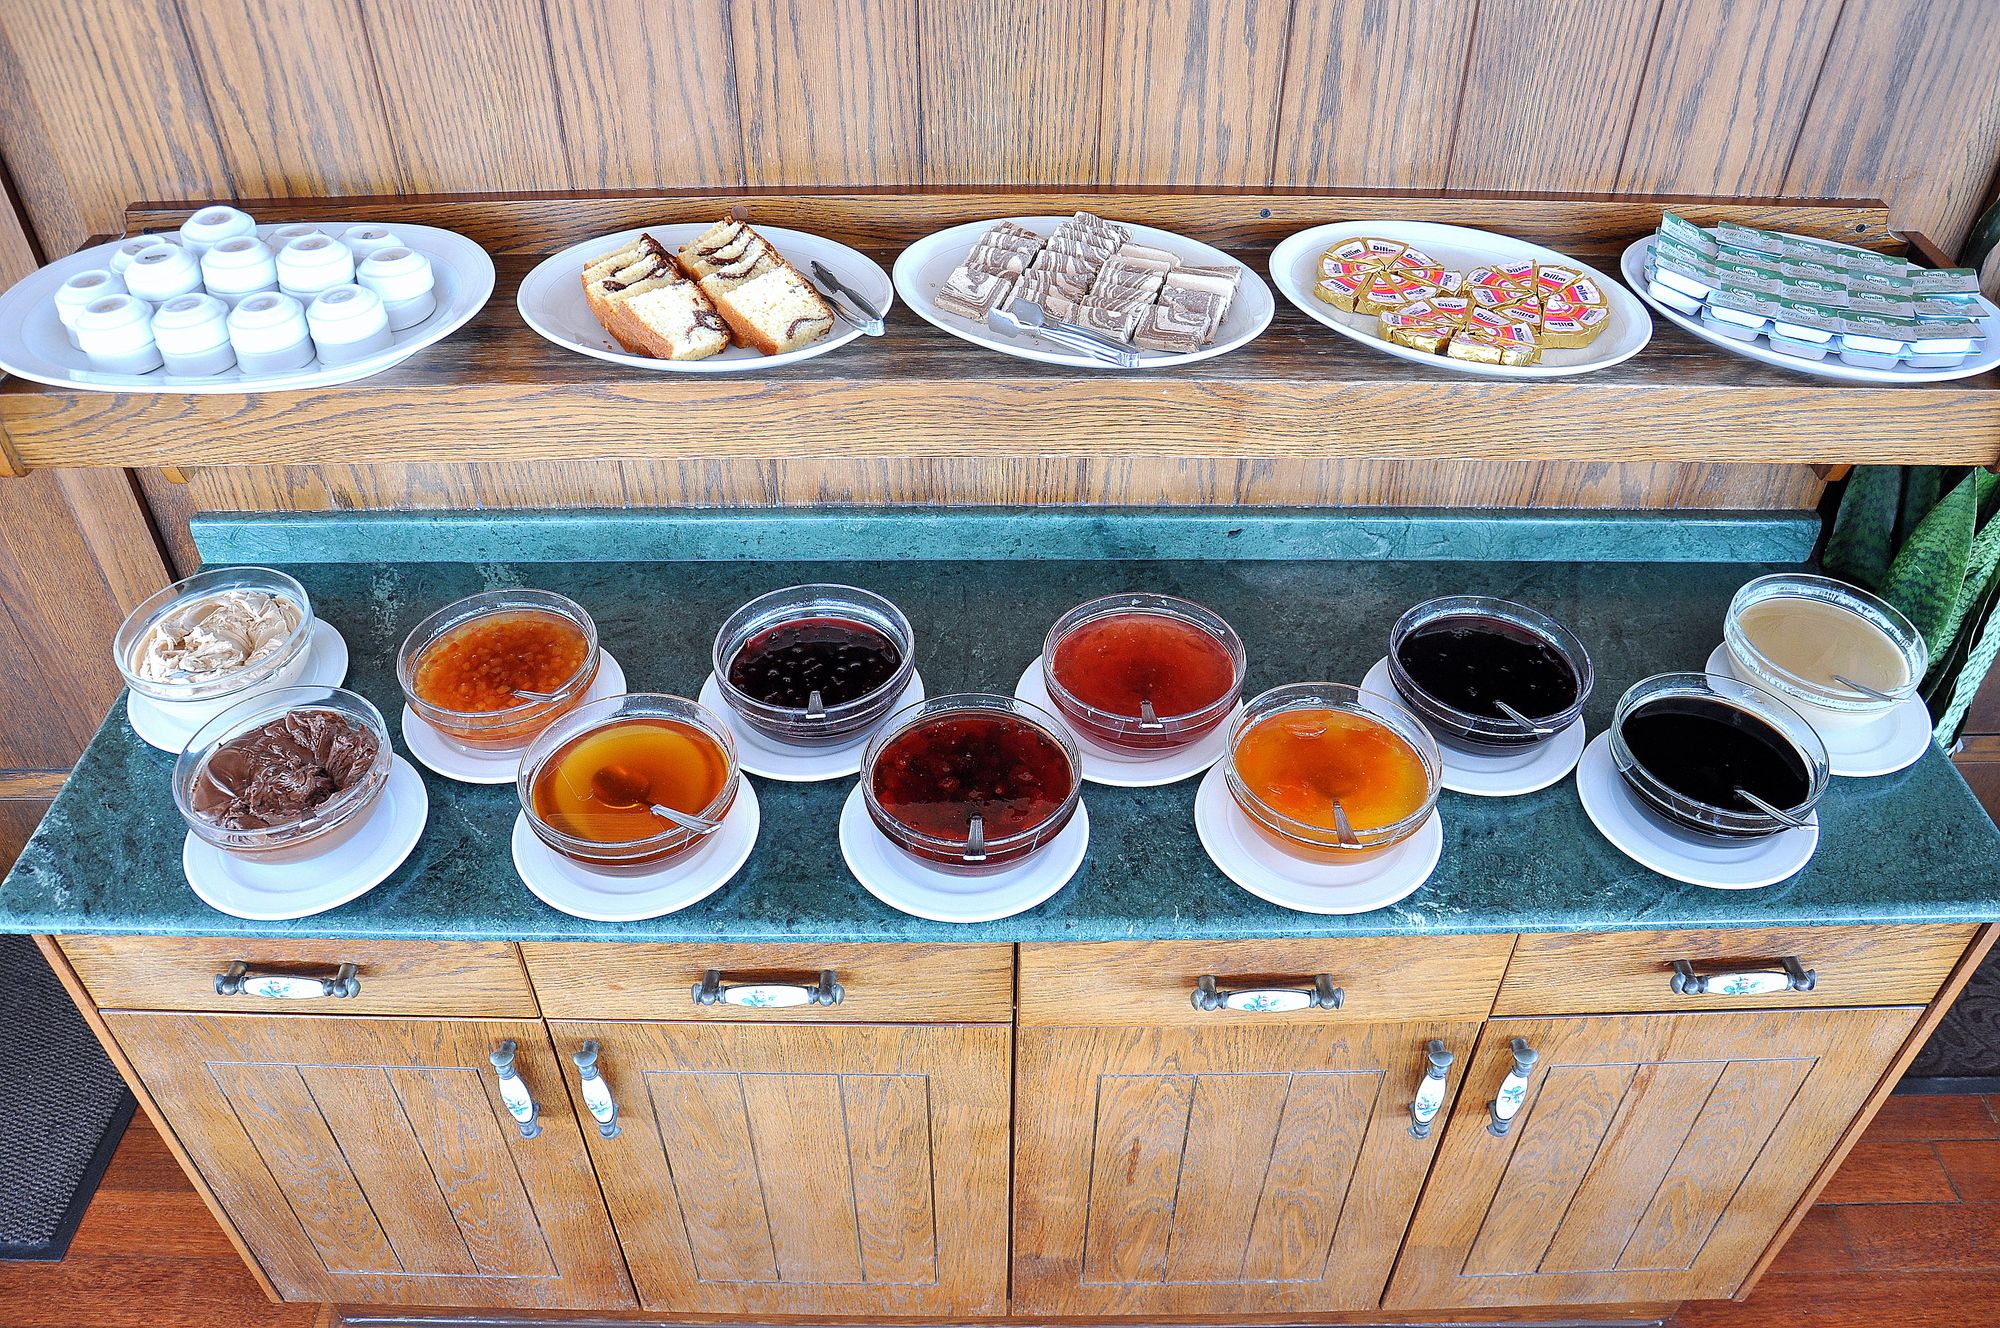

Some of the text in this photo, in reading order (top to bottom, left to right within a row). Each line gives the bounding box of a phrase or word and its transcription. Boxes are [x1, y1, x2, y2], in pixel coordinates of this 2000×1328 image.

[1342, 248, 1362, 258] Dilim
[1372, 245, 1396, 253] Dilim
[1506, 265, 1530, 274] Dilim
[1474, 272, 1488, 282] Dilim
[1542, 272, 1567, 282] Dilim
[1330, 280, 1350, 292] Dilim
[1576, 285, 1589, 301] Dilim
[1476, 312, 1500, 324] Dilim
[1512, 310, 1536, 319] Dilim
